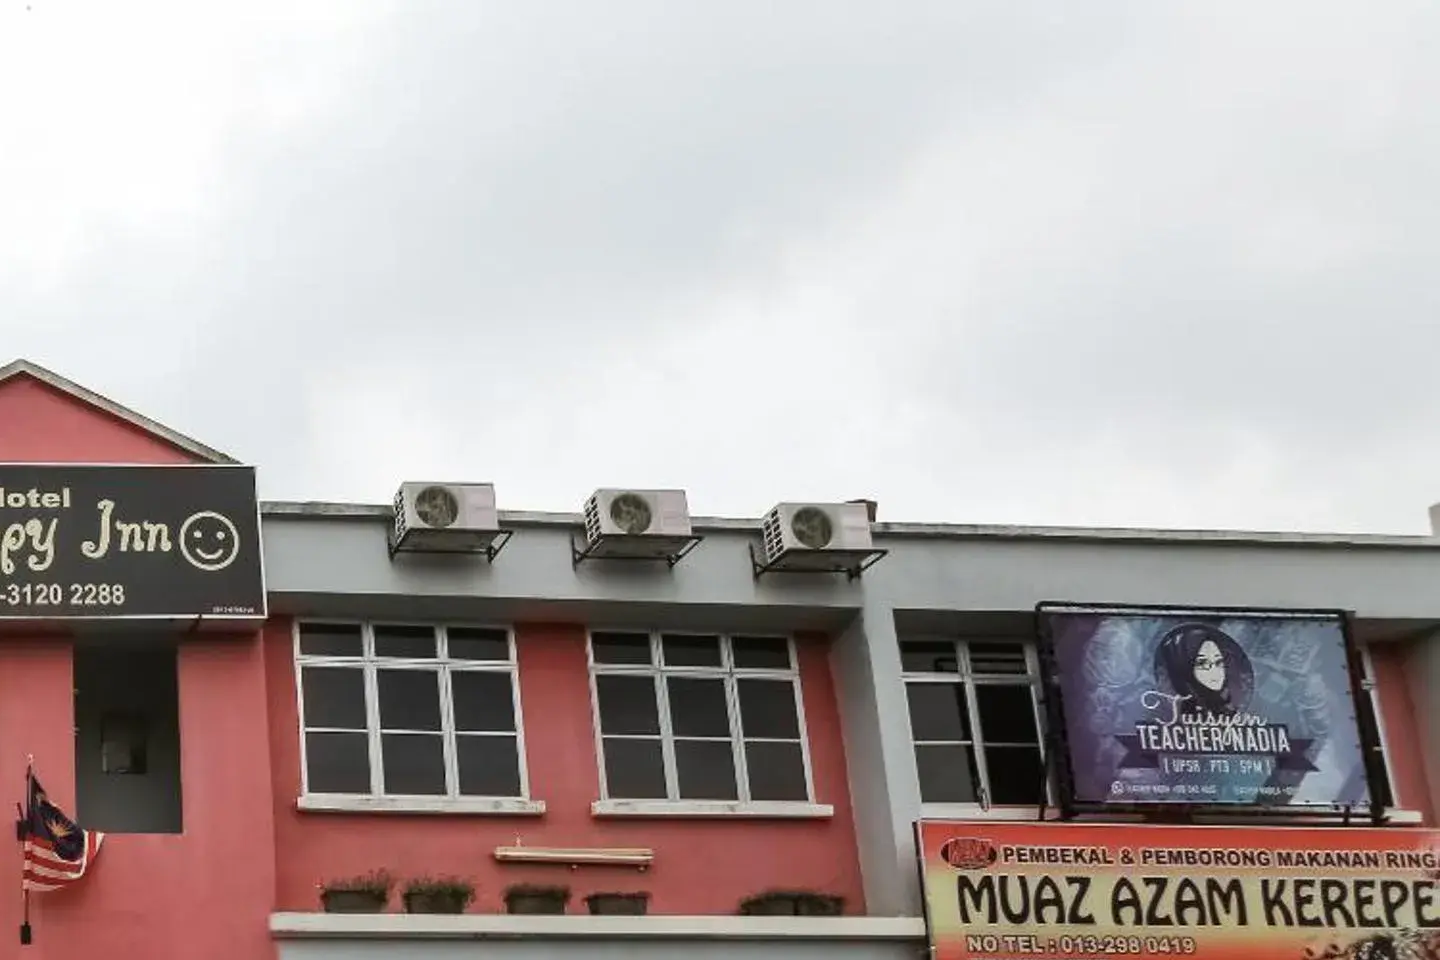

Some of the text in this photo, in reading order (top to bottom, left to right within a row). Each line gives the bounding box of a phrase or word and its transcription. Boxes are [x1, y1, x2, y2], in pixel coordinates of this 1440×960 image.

[70, 584, 125, 605] 2288
[1136, 725, 1291, 753] TEACHER NADIA
[1004, 847, 1113, 865] PEMBEKAL
[1121, 848, 1134, 865] &
[1142, 849, 1270, 866] PEMBORONG
[1278, 851, 1378, 867] MAKANAN
[1387, 852, 1440, 868] RING
[957, 875, 1440, 928] MUAZ AZAM KEREPE
[967, 936, 998, 953] NO
[1062, 936, 1140, 954] 013-298
[1146, 937, 1196, 954] 0419
